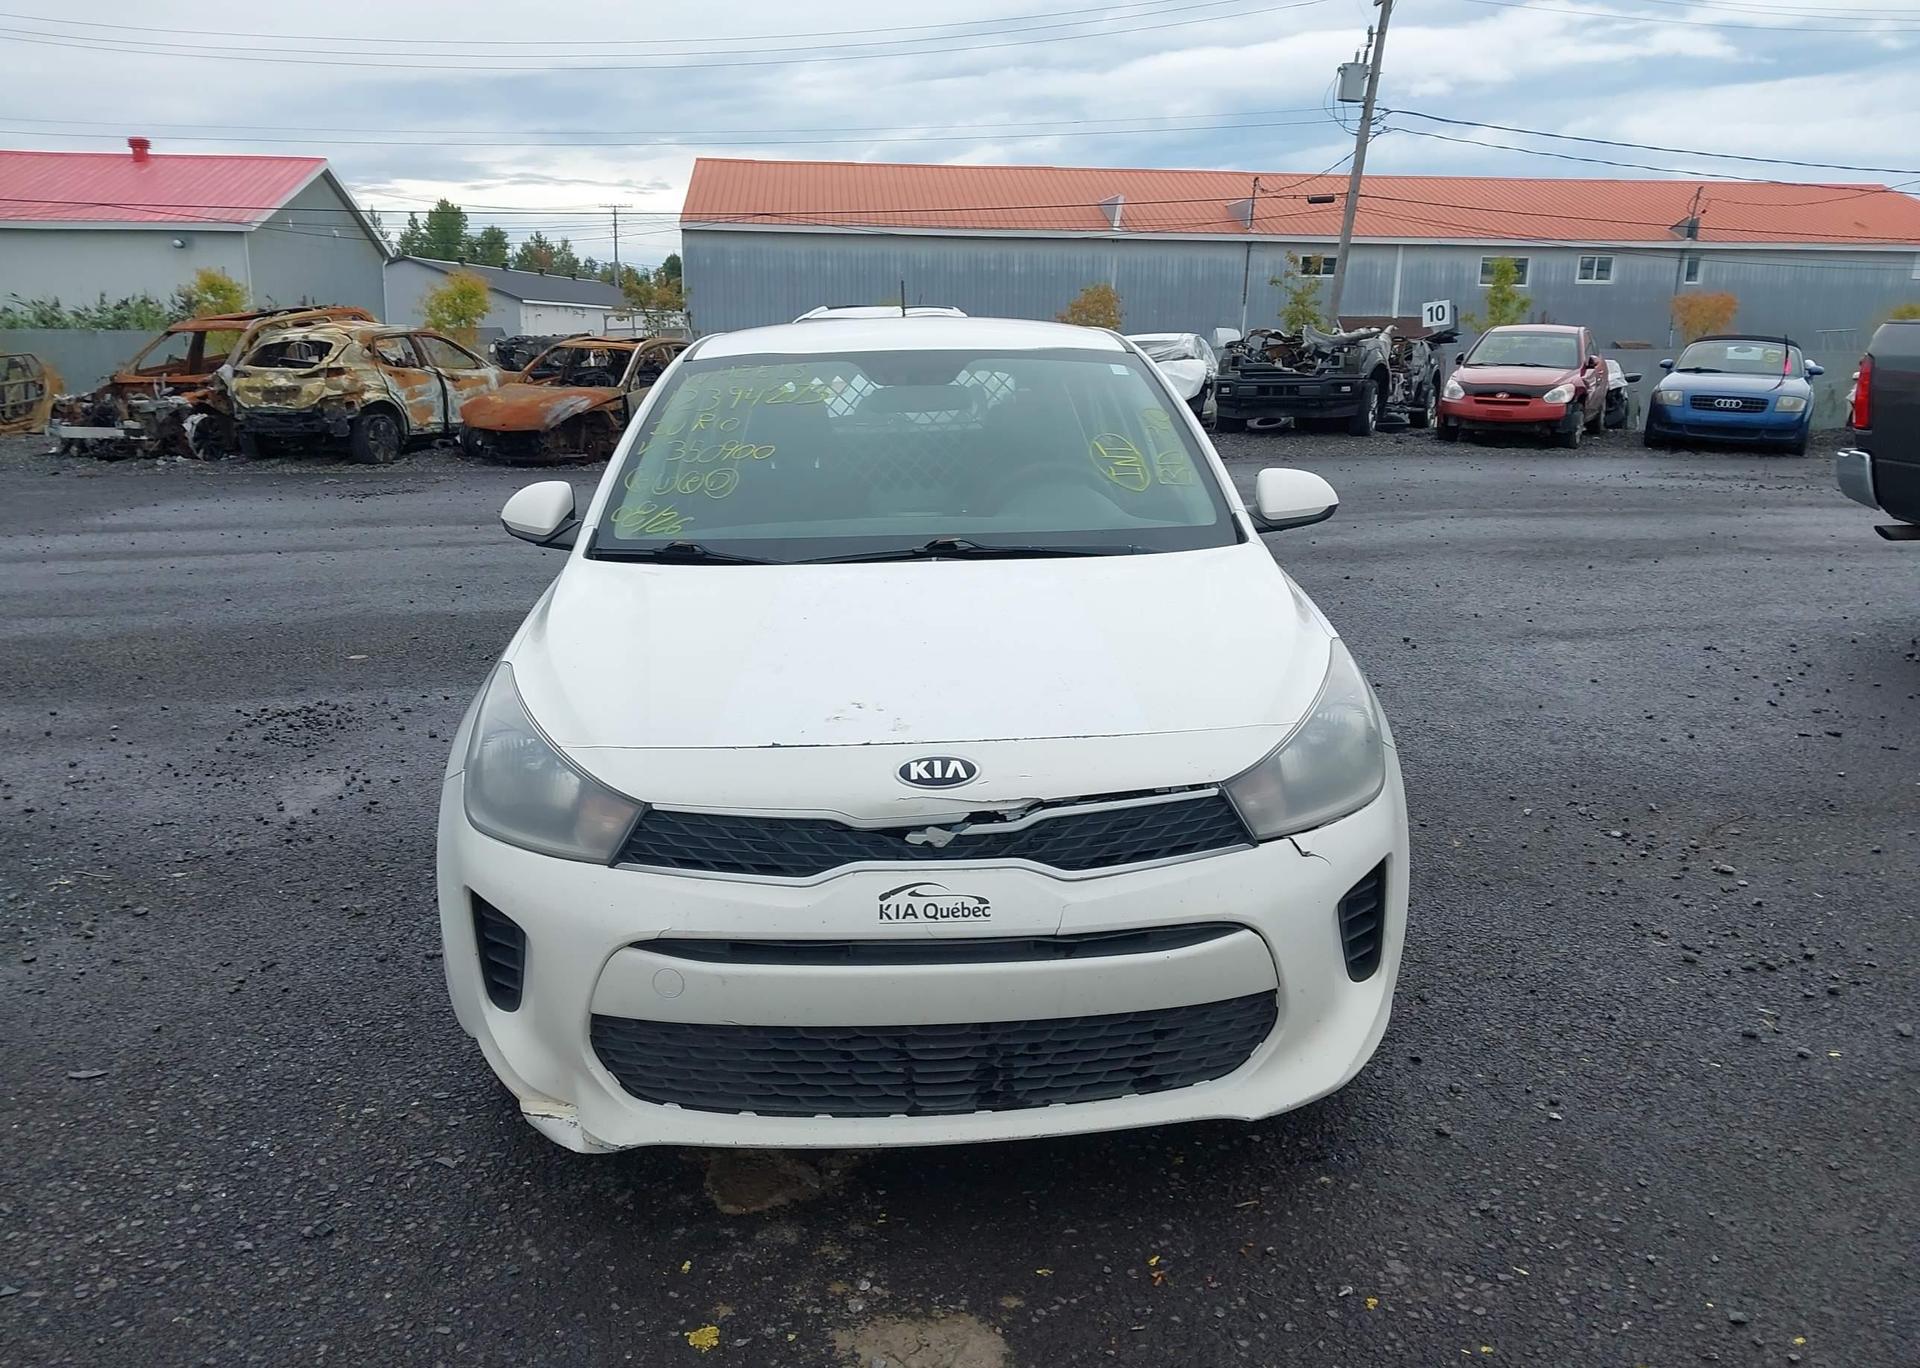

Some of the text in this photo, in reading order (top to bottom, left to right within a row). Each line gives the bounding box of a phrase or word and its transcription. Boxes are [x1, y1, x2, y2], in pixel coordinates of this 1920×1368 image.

[1427, 305, 1446, 323] 10
[909, 760, 968, 780] KIA
[879, 901, 991, 921] KIA Québec
